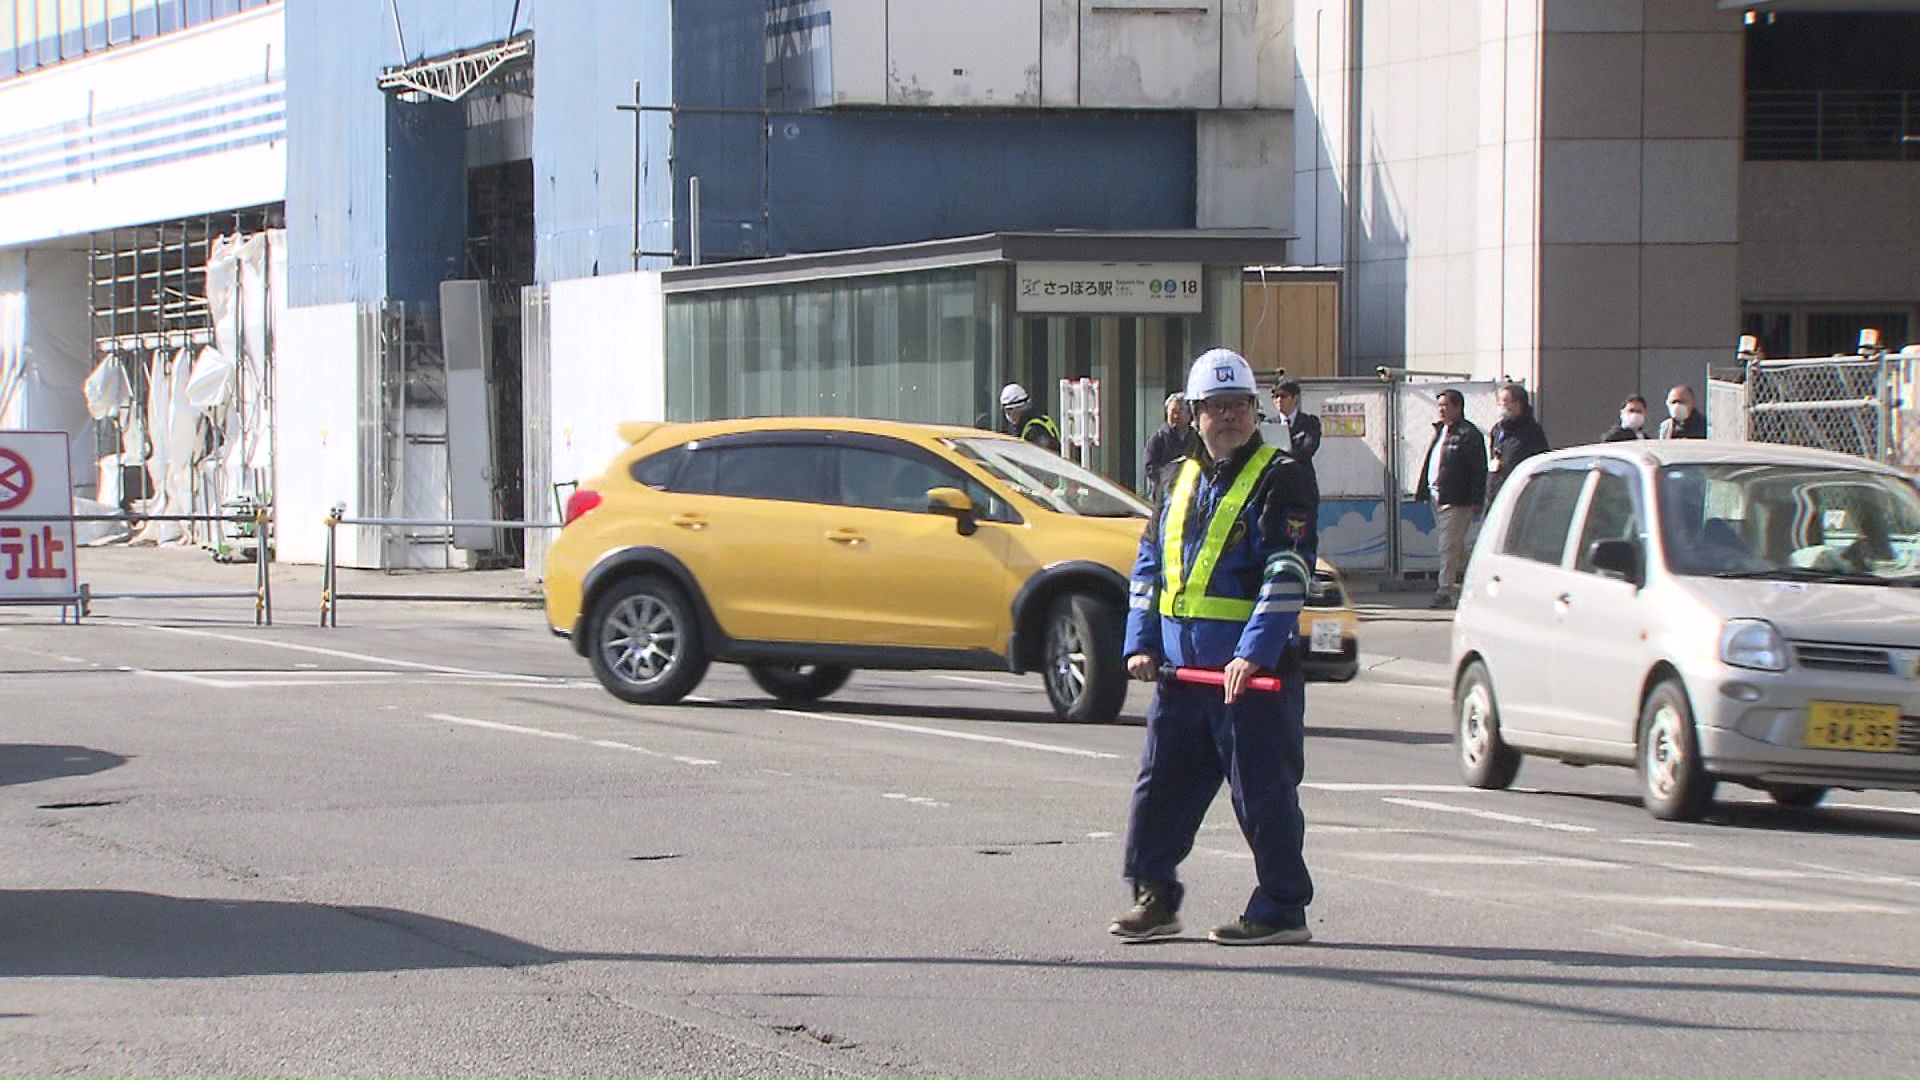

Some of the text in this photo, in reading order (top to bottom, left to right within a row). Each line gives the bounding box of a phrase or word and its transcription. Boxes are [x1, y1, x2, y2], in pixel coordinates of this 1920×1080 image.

[1043, 281, 1113, 296] さっぽろ駅
[1181, 280, 1198, 295] 18
